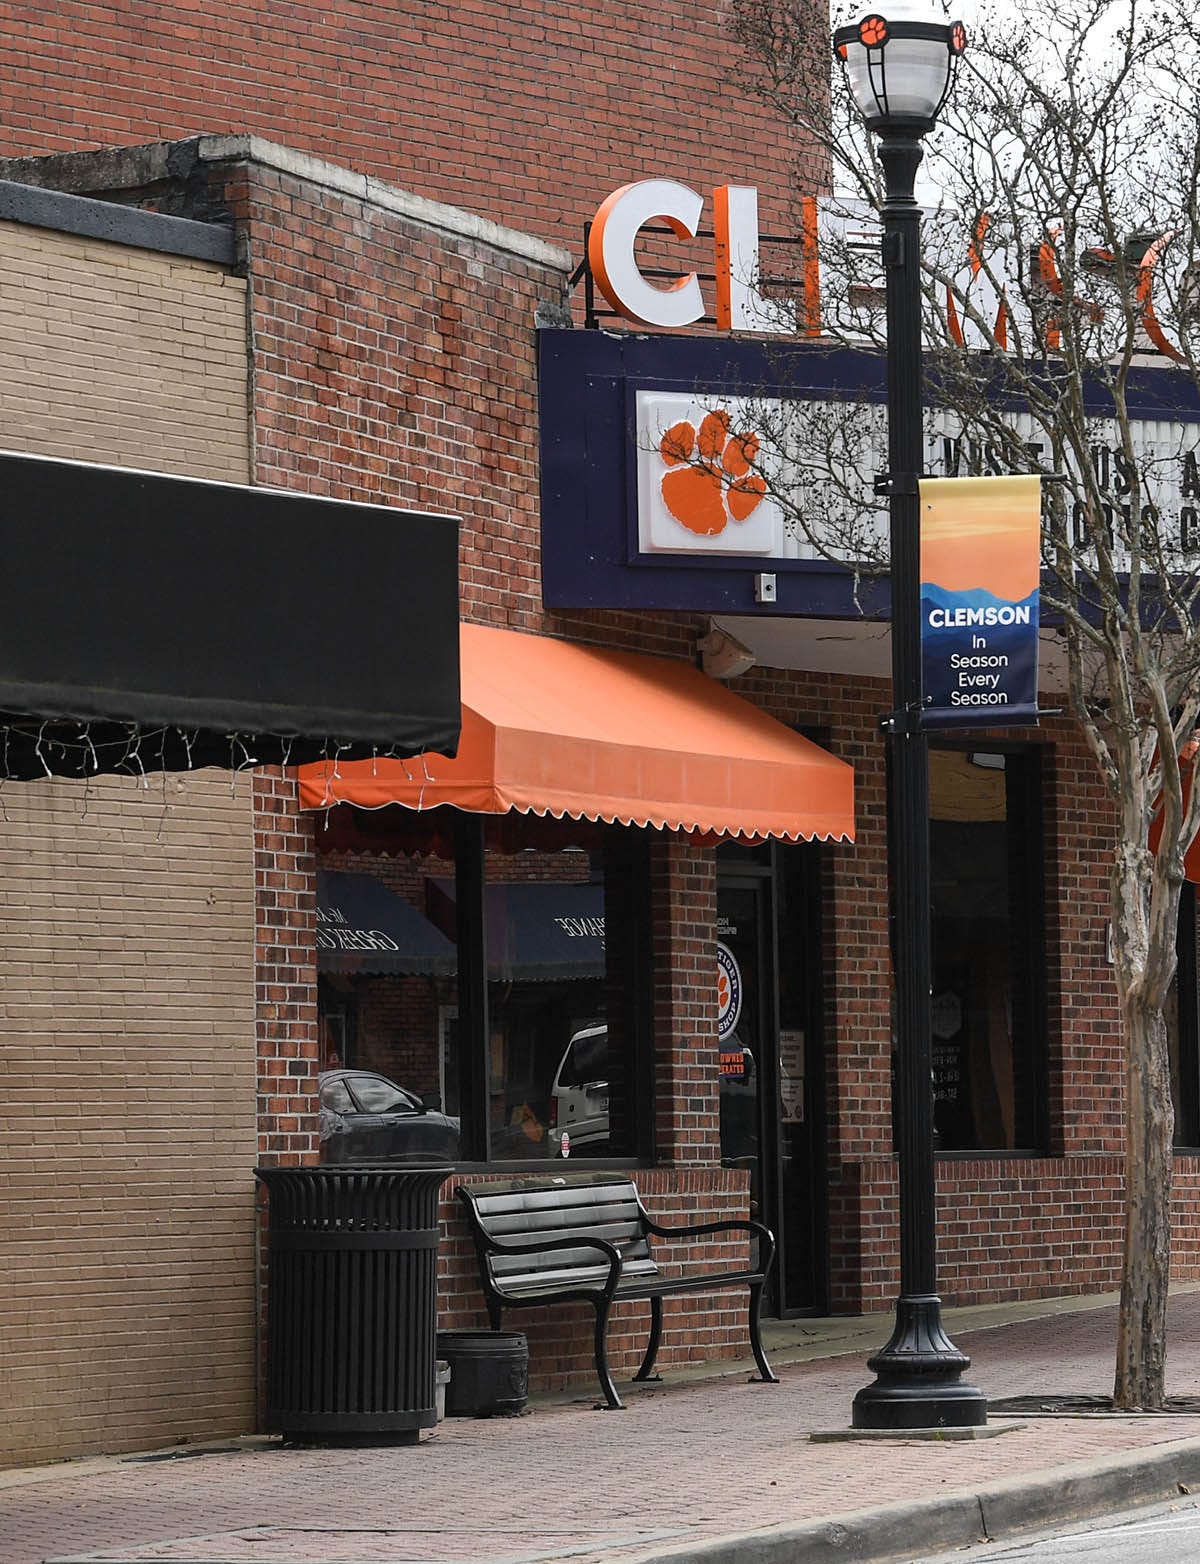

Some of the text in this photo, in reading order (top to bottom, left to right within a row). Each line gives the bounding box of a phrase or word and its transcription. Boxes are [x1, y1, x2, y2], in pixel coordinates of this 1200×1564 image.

[929, 606, 1030, 627] CLEMSON
[972, 635, 986, 648] In
[950, 653, 1008, 668] Season
[958, 672, 1000, 689] Every
[951, 691, 1008, 705] Season
[718, 951, 737, 990] TIGER
[719, 1002, 736, 1032] SHOP
